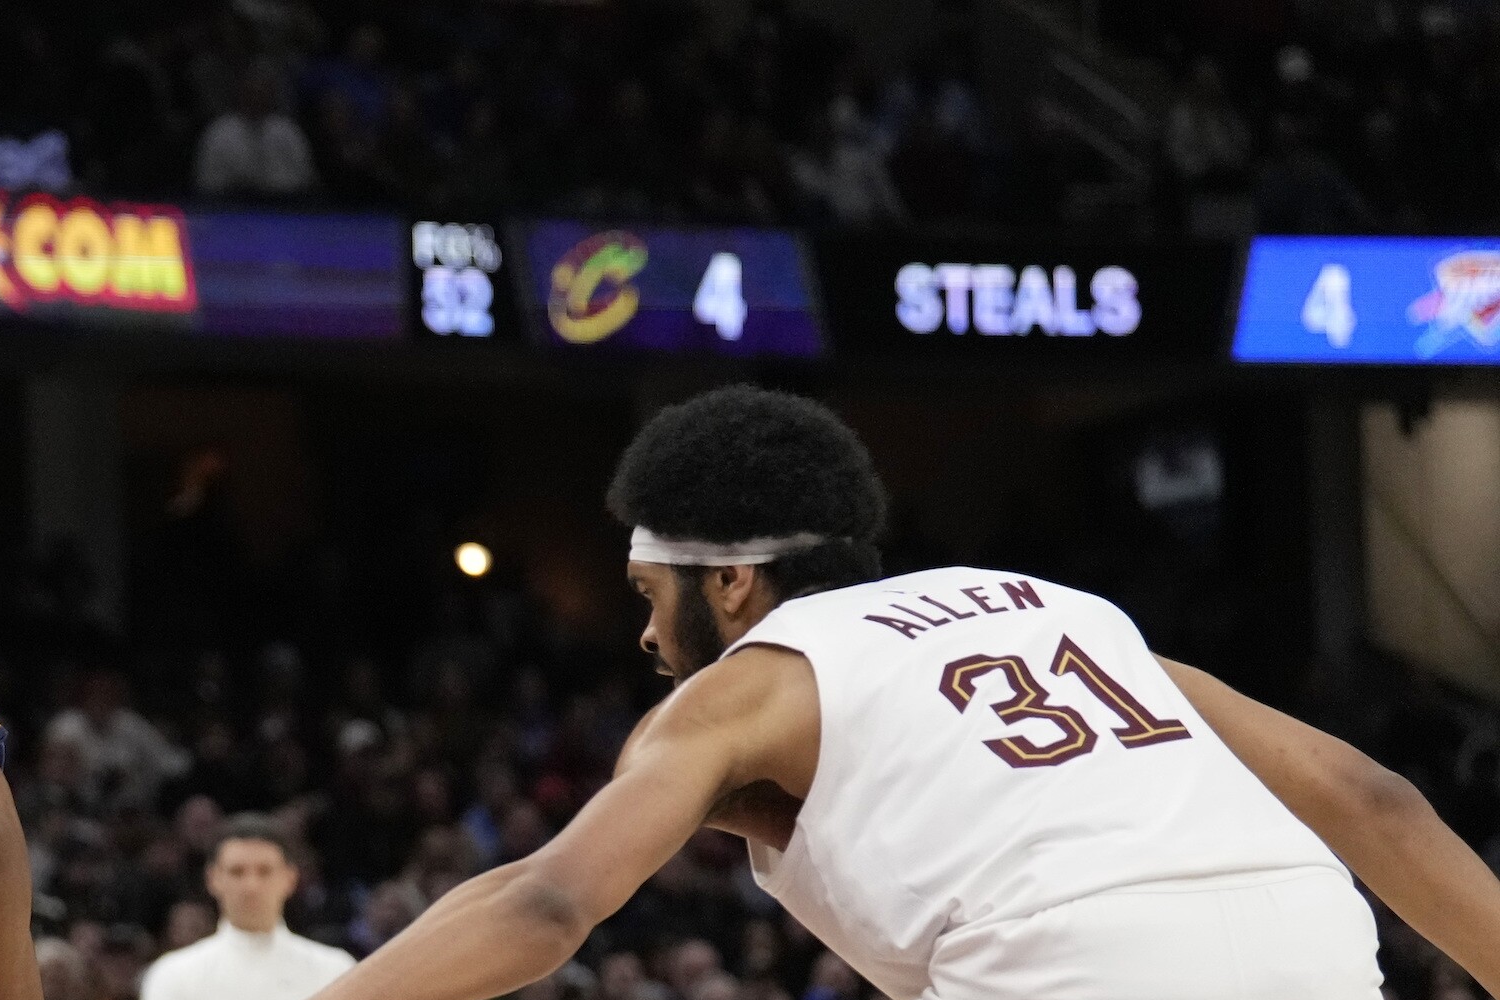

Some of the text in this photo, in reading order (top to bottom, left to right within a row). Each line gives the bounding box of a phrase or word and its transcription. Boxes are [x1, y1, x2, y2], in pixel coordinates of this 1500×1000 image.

[10, 205, 188, 302] COM
[694, 252, 748, 342] 4
[894, 262, 1142, 337] STEALS
[1303, 263, 1356, 350] 4
[862, 580, 1046, 640] ALLEN
[938, 633, 1193, 768] 31
